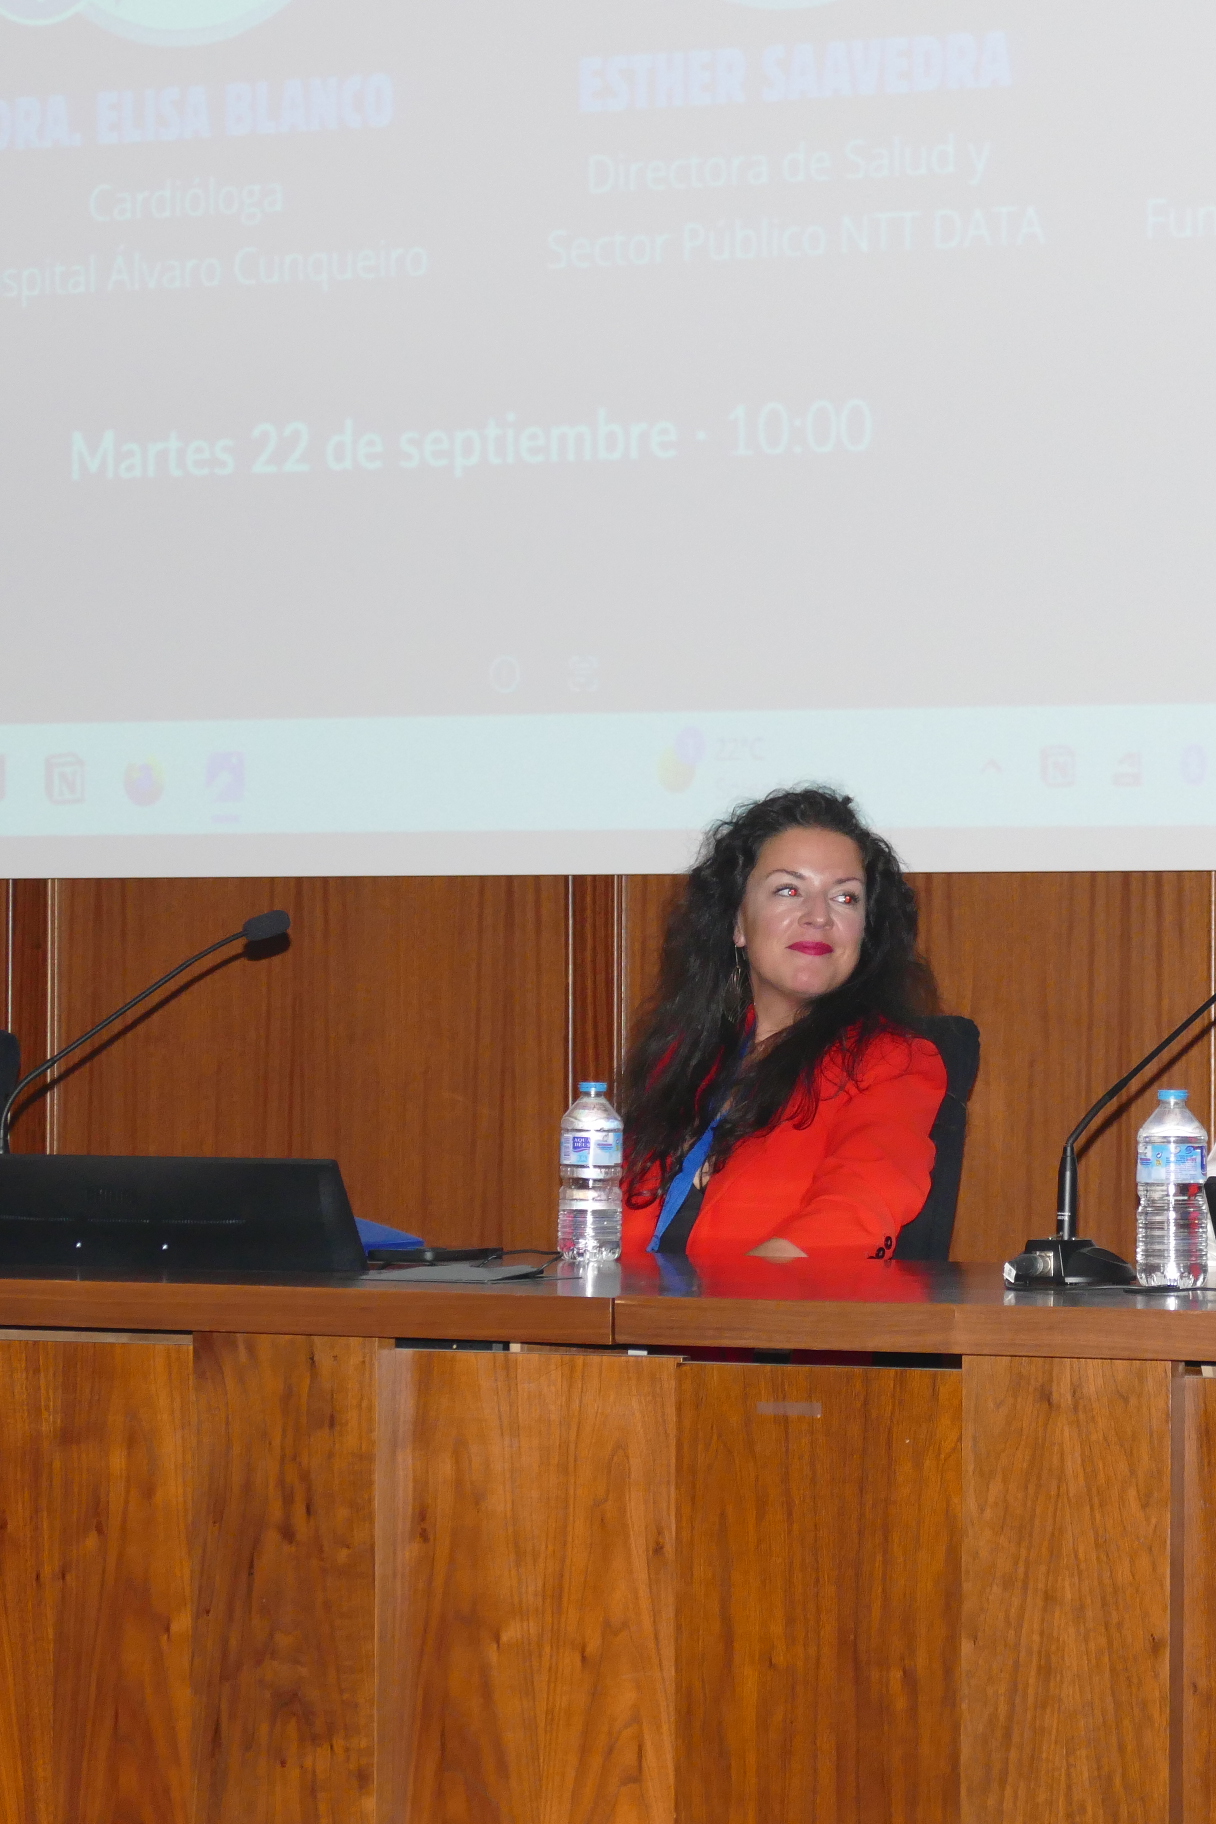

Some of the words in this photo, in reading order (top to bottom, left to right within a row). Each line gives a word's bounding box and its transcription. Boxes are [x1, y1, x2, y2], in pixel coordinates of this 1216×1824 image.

[579, 48, 747, 111] ESTHER
[763, 30, 1012, 101] SAAVEDRA
[98, 86, 211, 143] ELISA
[226, 73, 394, 135] BLANCO
[589, 154, 770, 193] Directora
[782, 142, 832, 182] de
[845, 133, 956, 179] Salud
[969, 143, 990, 185] y
[90, 176, 285, 226] Cardióloga
[108, 245, 223, 290] Álvaro
[234, 240, 430, 292] Cunqueiro
[548, 230, 671, 268] Sector
[684, 218, 828, 260] Público
[842, 211, 921, 252] NTT
[935, 206, 1045, 249] DATA
[72, 430, 235, 479] Martes
[252, 421, 309, 473] 22
[326, 418, 383, 470] de
[400, 407, 679, 477] septiembre
[729, 398, 873, 455] 10:00
